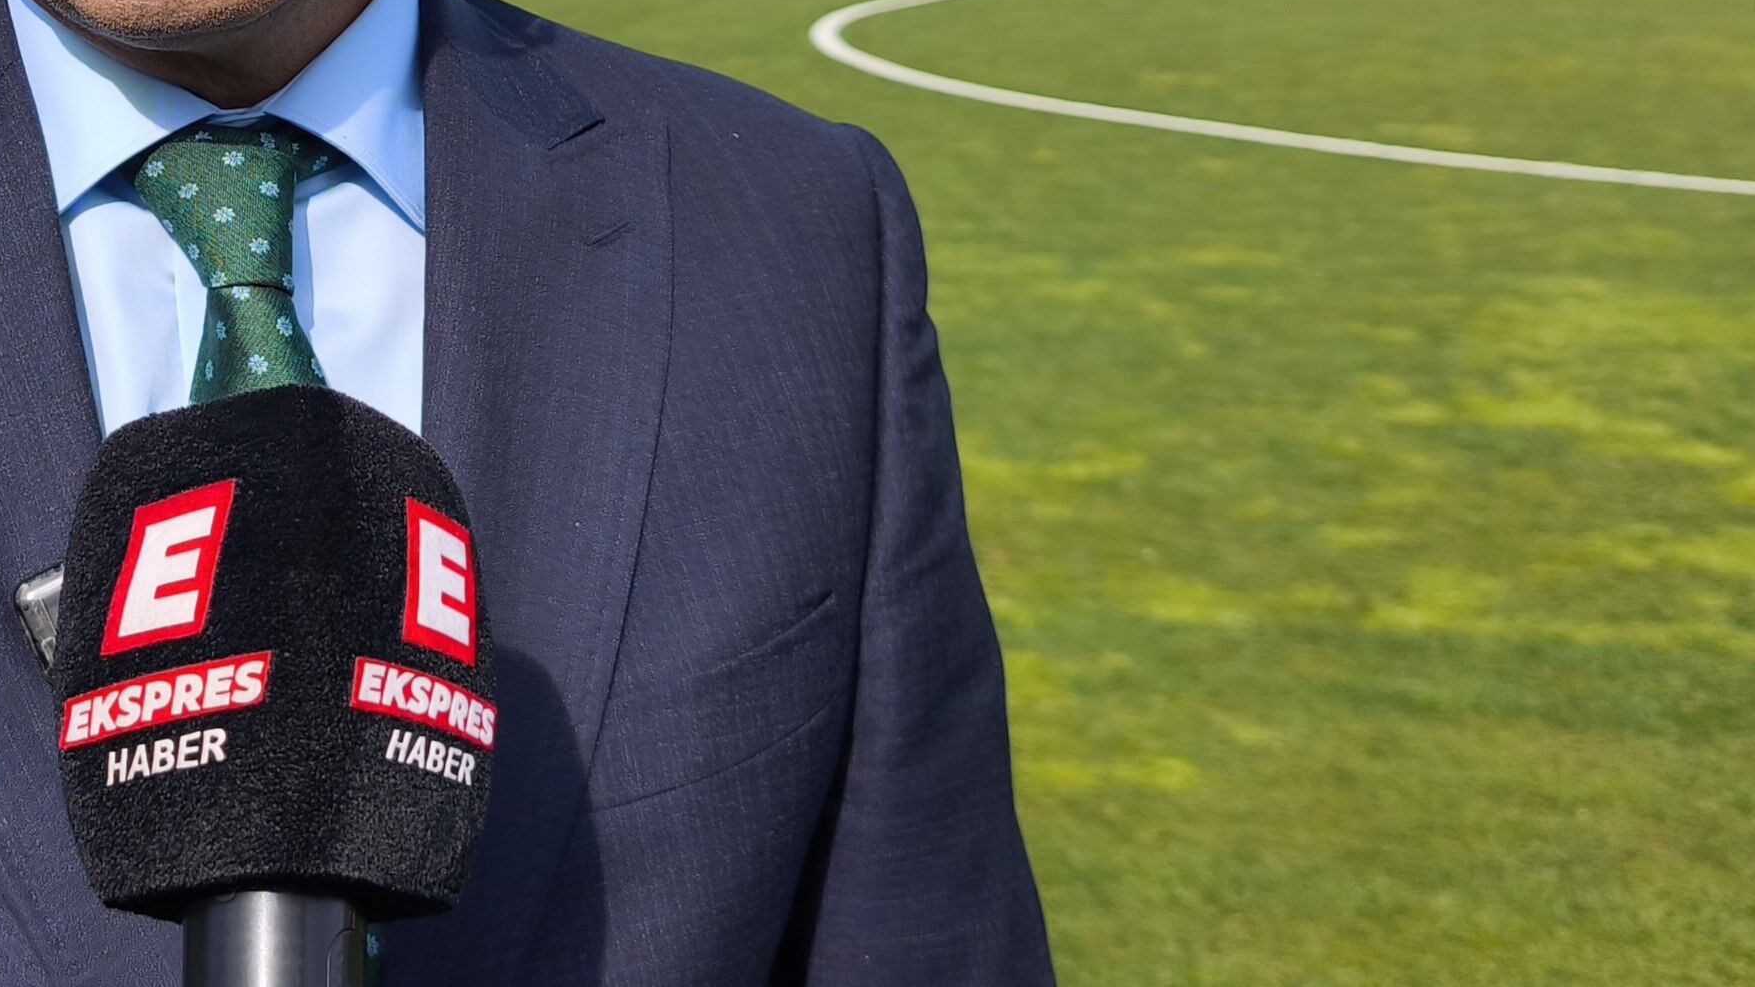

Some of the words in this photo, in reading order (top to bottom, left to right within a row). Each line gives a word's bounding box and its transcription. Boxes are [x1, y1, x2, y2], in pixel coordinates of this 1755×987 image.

[118, 506, 216, 637] E
[417, 519, 469, 646] E
[65, 660, 265, 743] EKSPRES
[358, 663, 495, 745] EKSPRES
[106, 728, 226, 786] HABER
[385, 729, 474, 785] HABER
